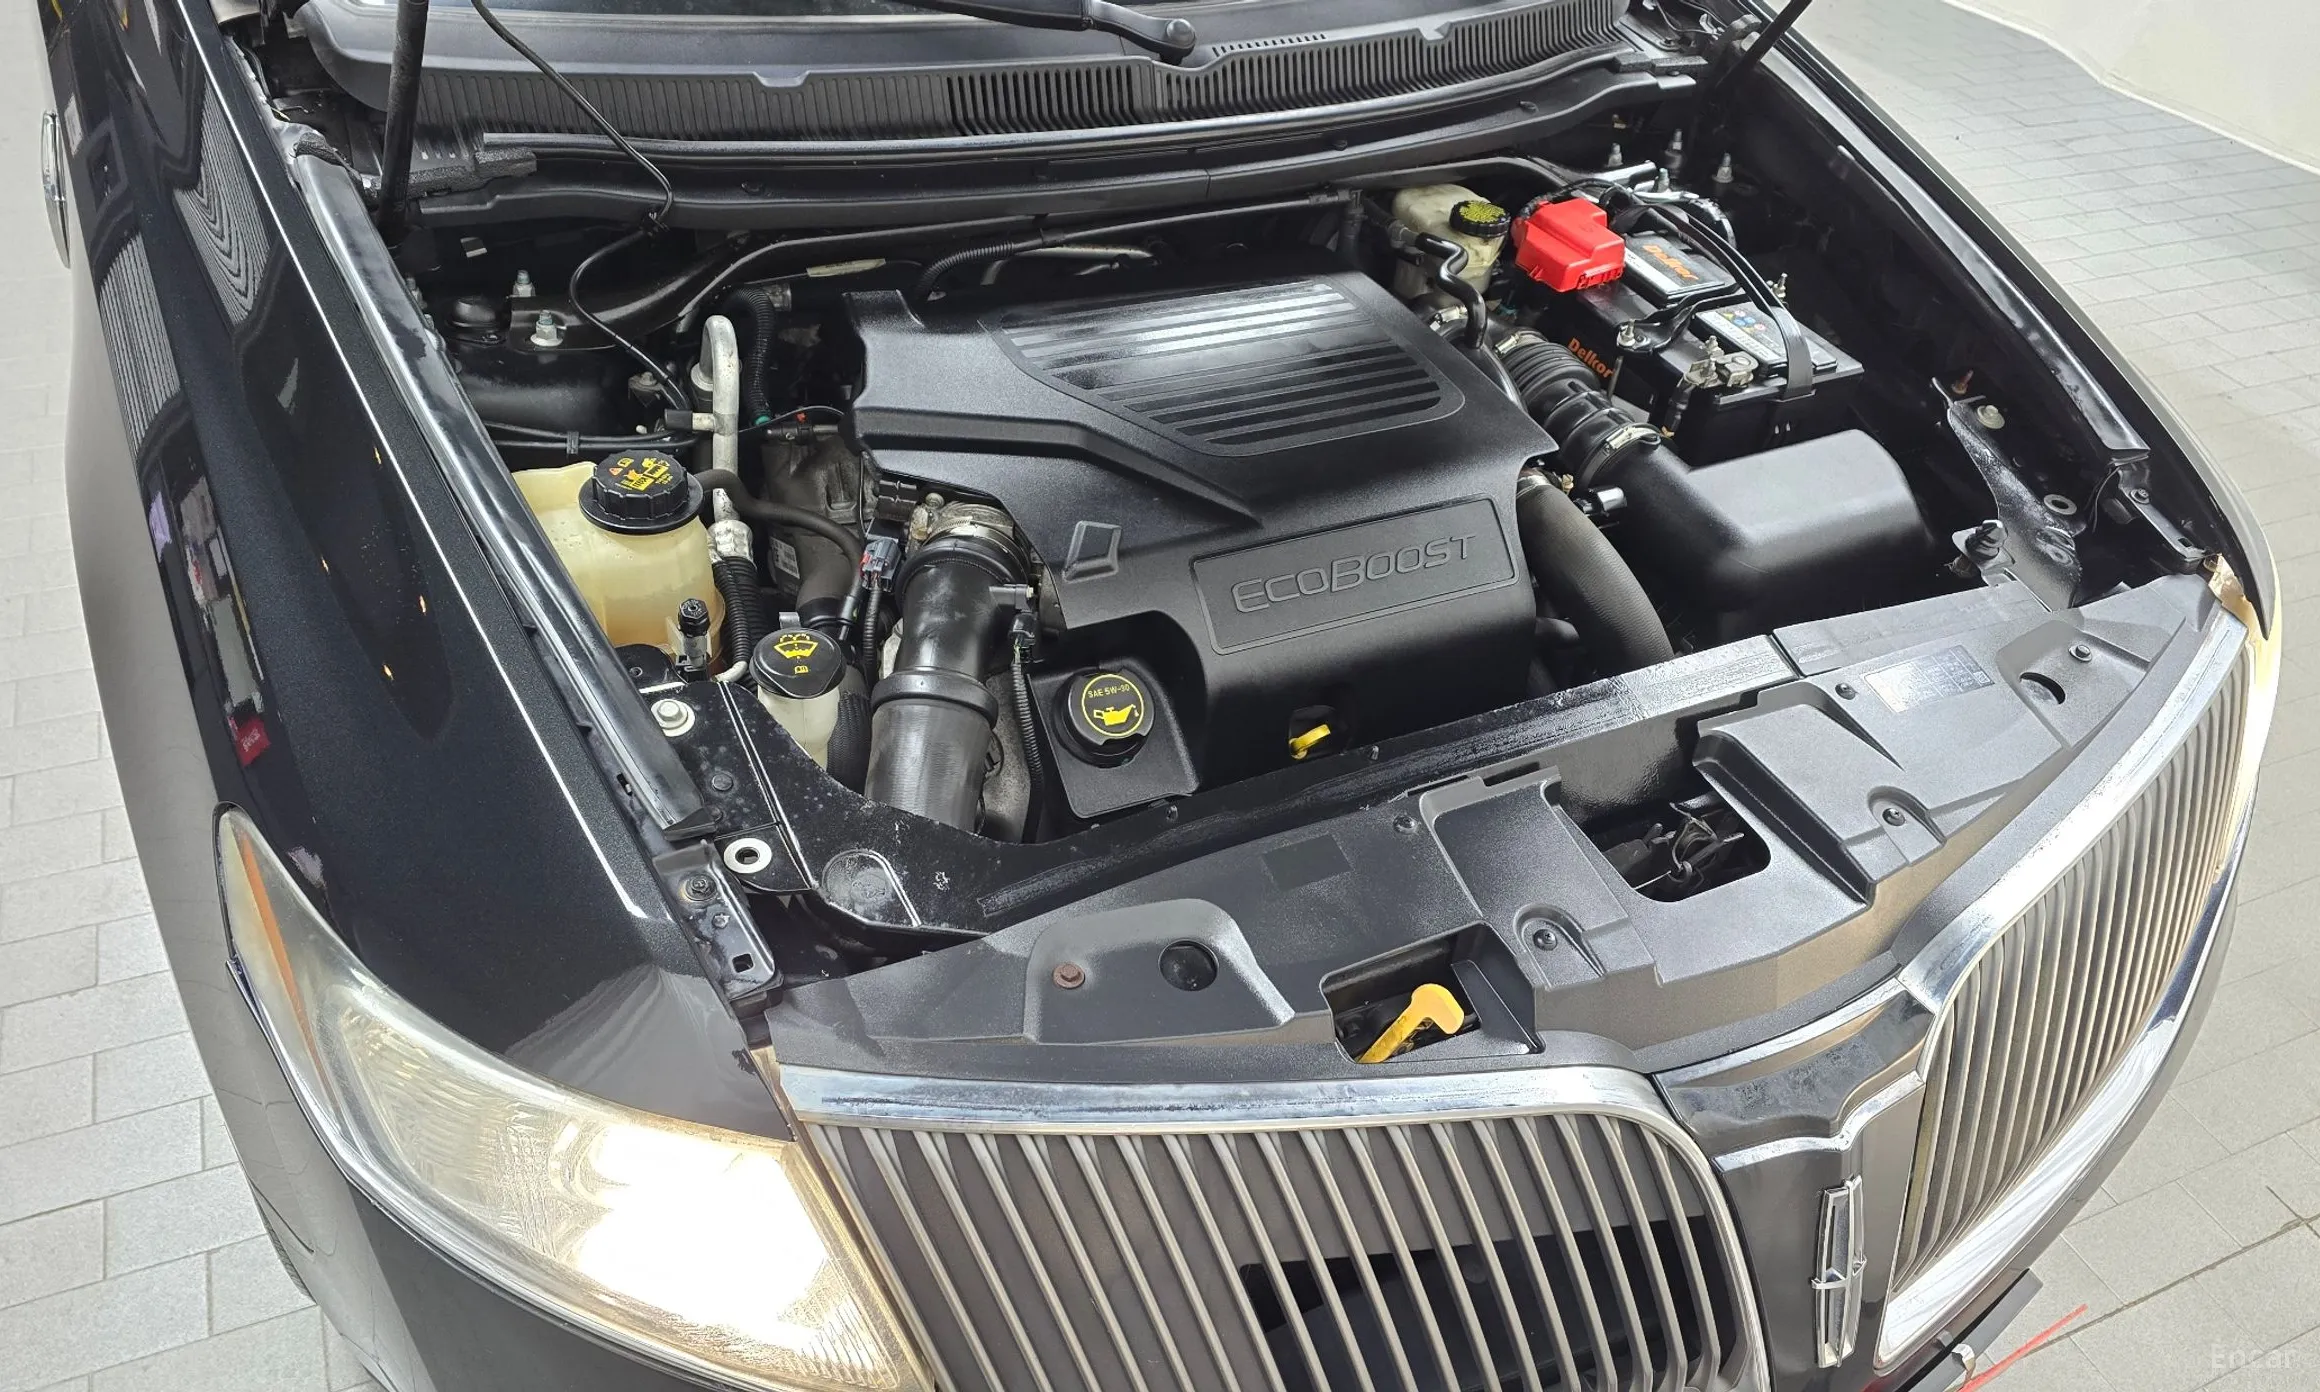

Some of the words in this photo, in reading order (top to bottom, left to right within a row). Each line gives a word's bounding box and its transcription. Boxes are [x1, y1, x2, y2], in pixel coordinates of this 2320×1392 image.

[1567, 337, 1614, 378] Delkor
[1087, 688, 1104, 699] SAE
[1104, 683, 1131, 696] 5W-30
